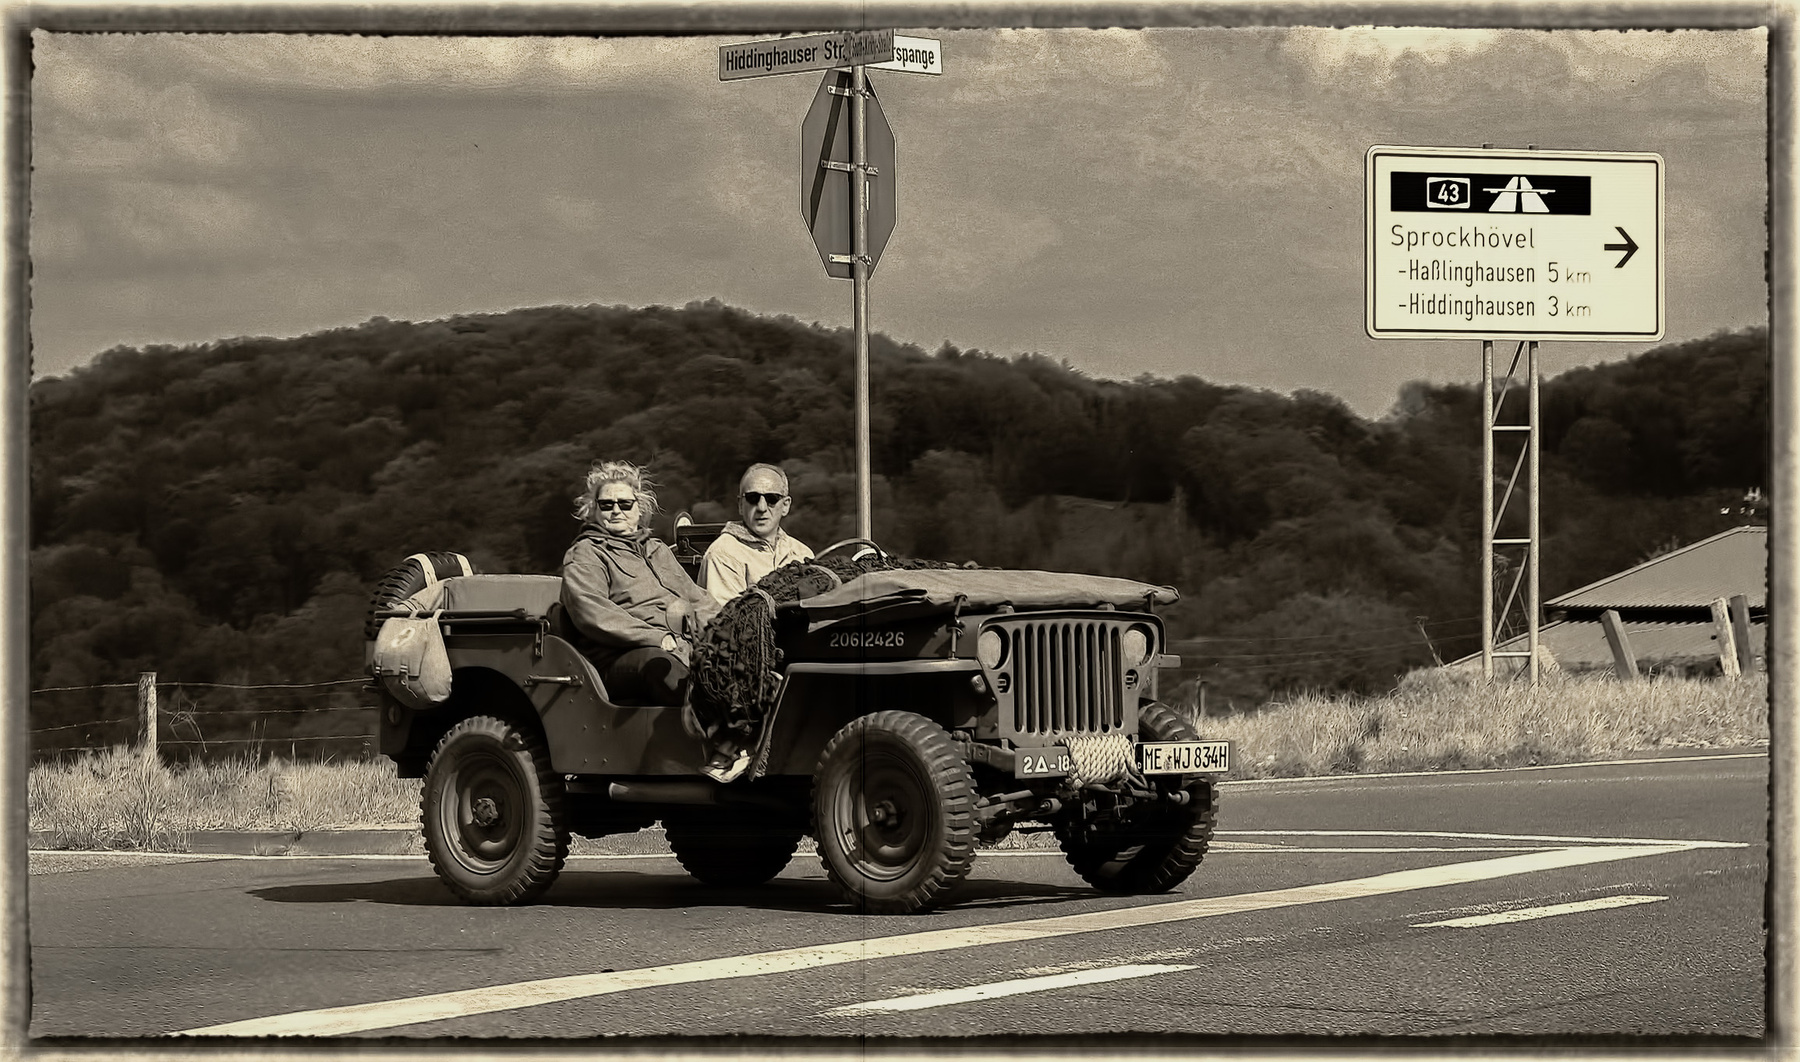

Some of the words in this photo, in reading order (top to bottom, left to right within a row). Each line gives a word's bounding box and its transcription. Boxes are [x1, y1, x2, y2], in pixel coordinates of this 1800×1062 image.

[726, 45, 818, 72] Hiddinghauser
[824, 39, 848, 62] Str.
[1437, 182, 1460, 203] 43
[1391, 224, 1535, 251] Sprockhövel
[1548, 262, 1559, 283] 5
[1566, 267, 1592, 284] km
[1398, 293, 1535, 321] -Hiddinghausen
[1548, 296, 1559, 317] 3
[1566, 301, 1592, 317] km
[830, 631, 905, 647] 20612426
[1144, 748, 1162, 770] ME
[1173, 747, 1191, 769] WJ
[1194, 746, 1227, 769] 834H
